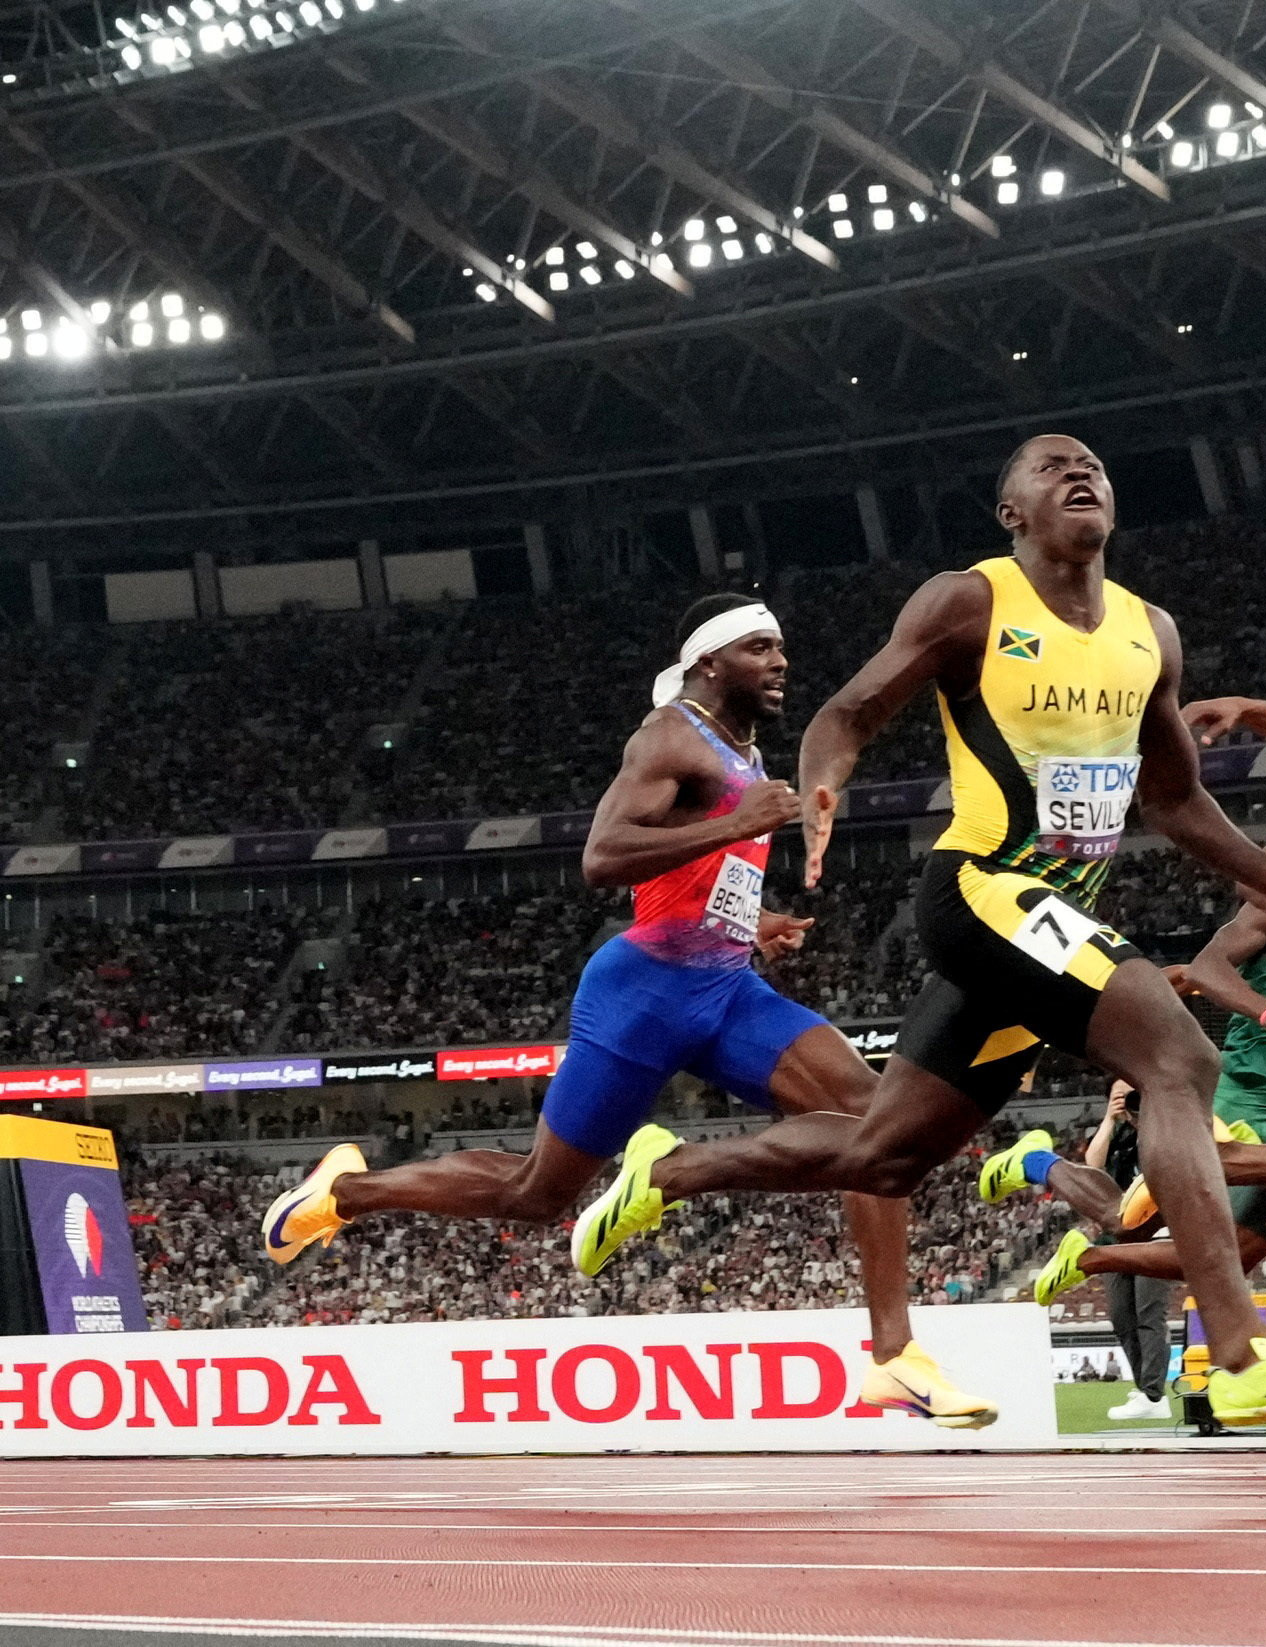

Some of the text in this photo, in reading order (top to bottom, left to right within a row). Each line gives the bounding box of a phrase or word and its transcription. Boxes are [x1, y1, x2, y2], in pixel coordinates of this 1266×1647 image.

[1080, 763, 1136, 792] TDK
[1031, 910, 1070, 949] 7
[452, 1340, 921, 1424] HOND
